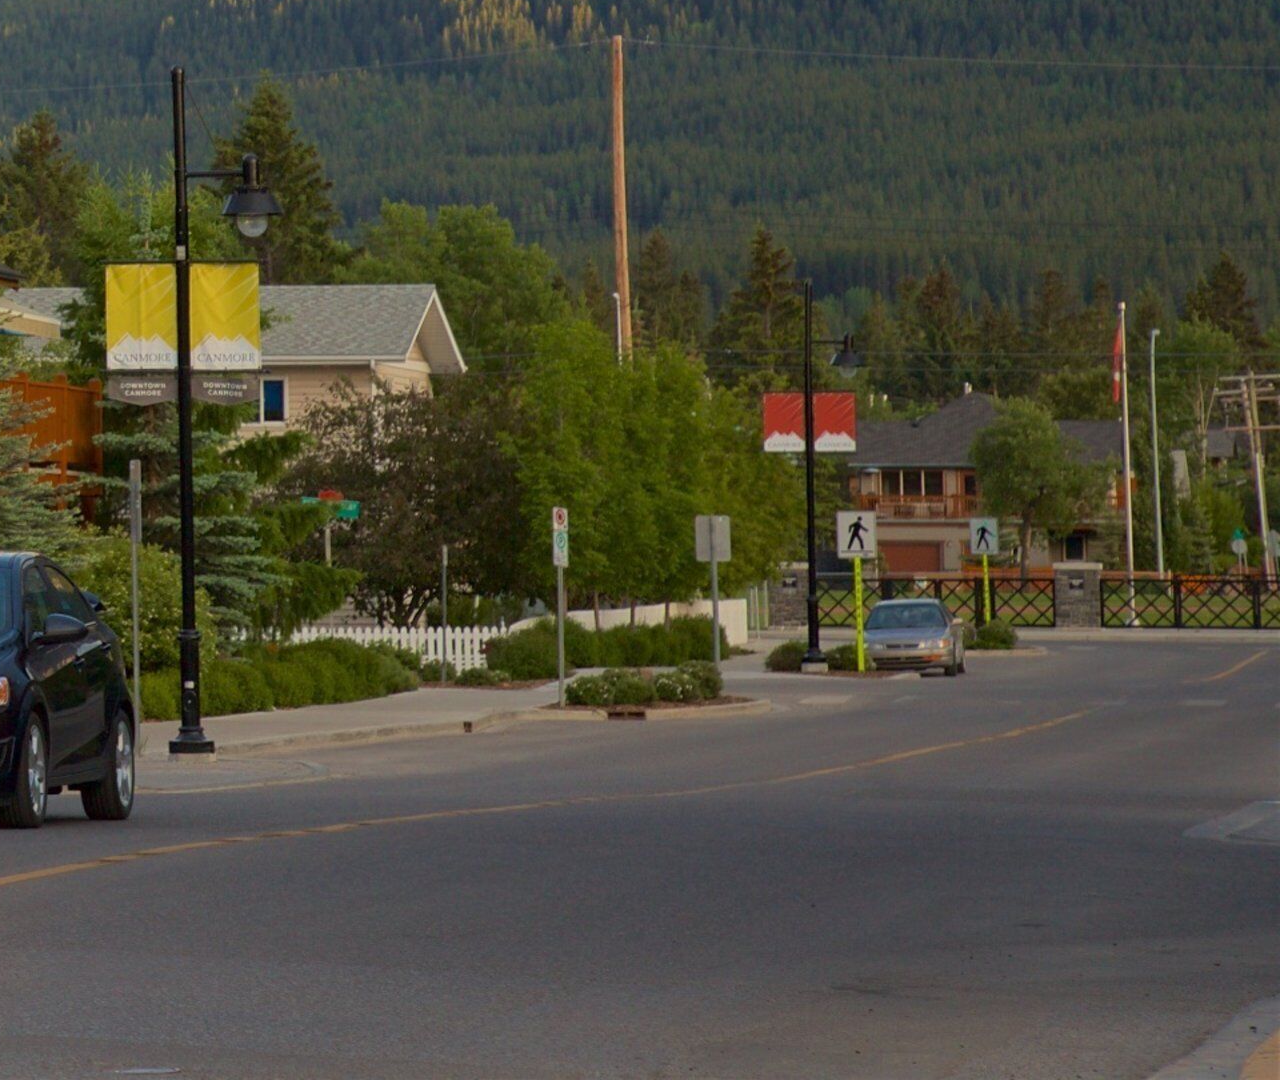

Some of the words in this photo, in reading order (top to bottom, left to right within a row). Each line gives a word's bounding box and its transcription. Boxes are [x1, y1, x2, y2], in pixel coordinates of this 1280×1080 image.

[113, 353, 172, 363] CANMORE
[197, 353, 256, 363] CANMORE
[202, 382, 248, 390] DOWNTOWN
